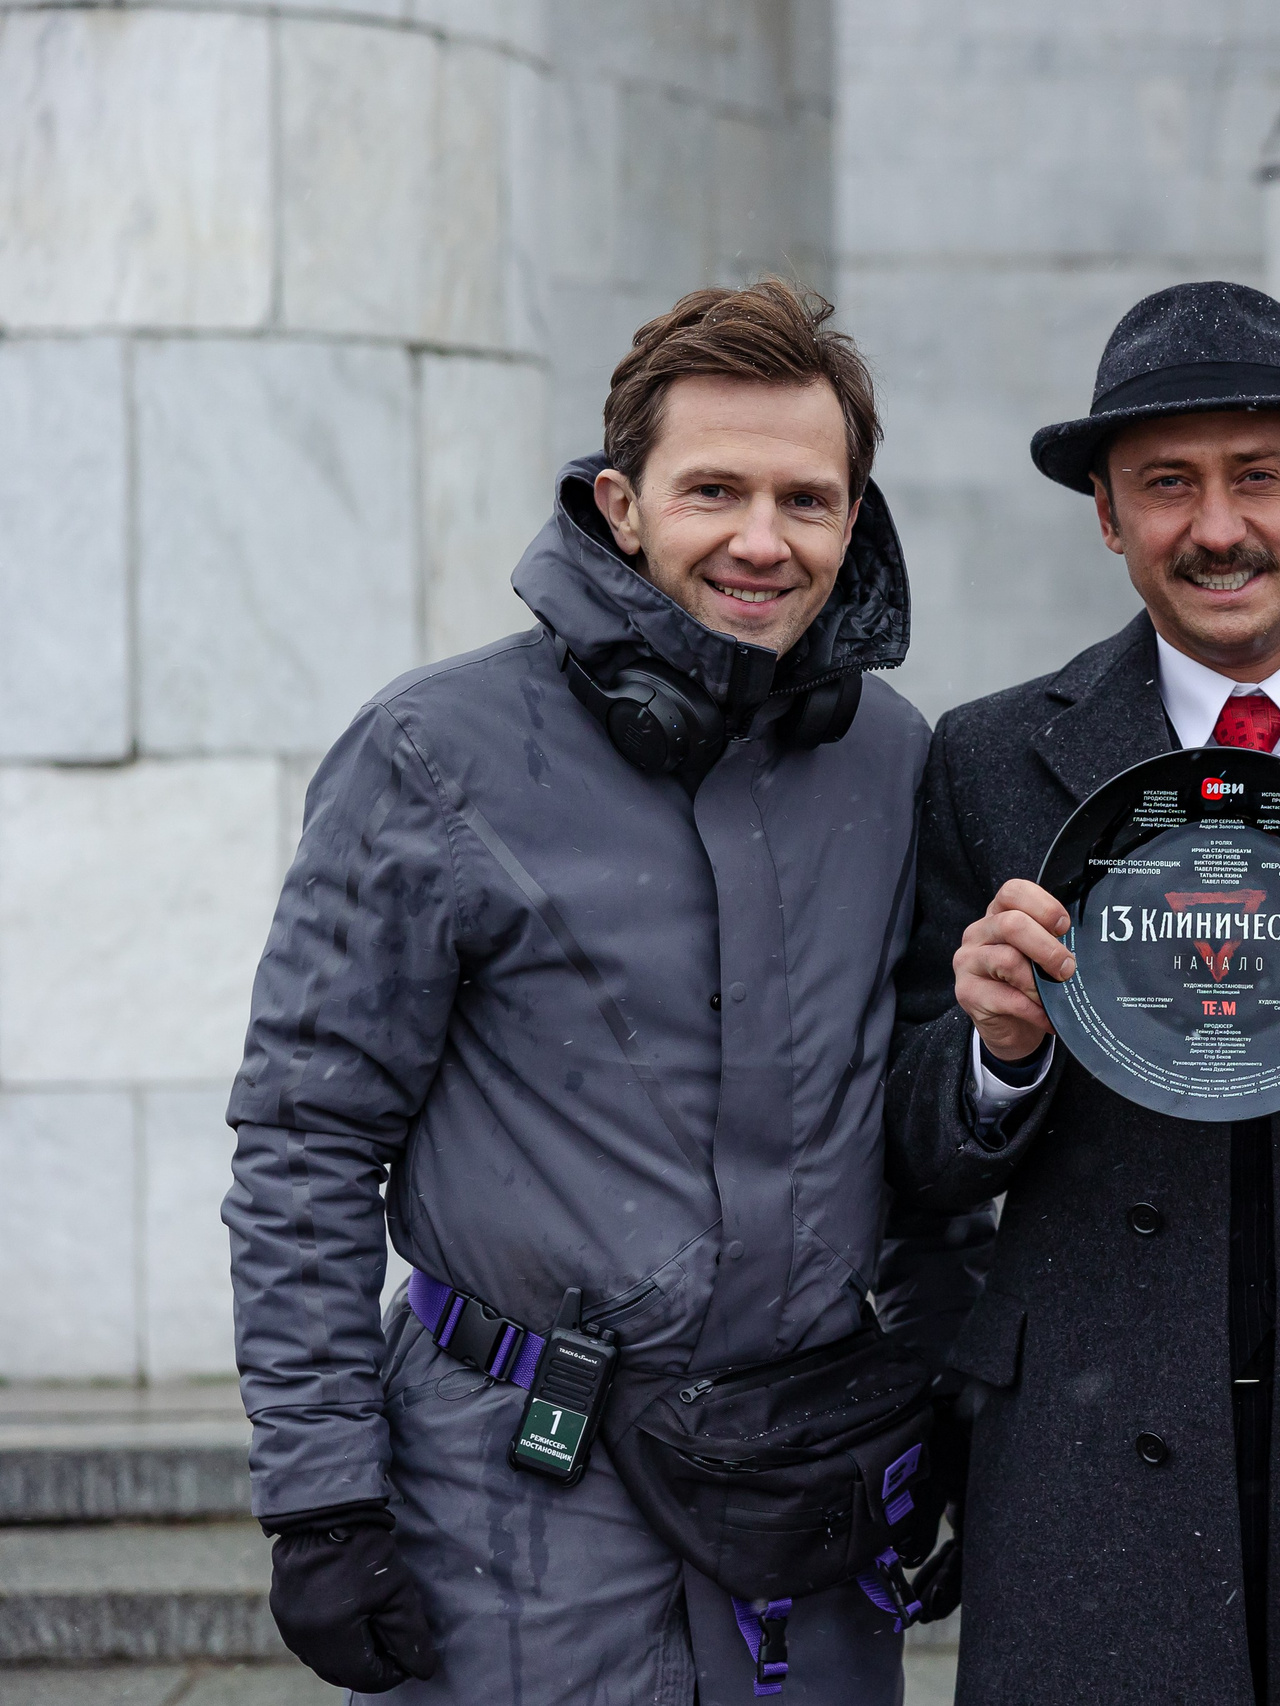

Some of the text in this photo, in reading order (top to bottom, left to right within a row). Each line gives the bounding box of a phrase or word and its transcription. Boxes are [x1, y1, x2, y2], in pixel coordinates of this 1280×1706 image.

[1088, 859, 1180, 868] РЕЖИССЁР-ПОСТАНОВЩИК
[1100, 906, 1133, 942] 13
[1174, 956, 1263, 970] НАЧАЛО
[551, 1410, 563, 1435] 1
[520, 1438, 572, 1462] ПОСТАНОВЩИК
[530, 1433, 568, 1450] РЕЖИССЕР-
